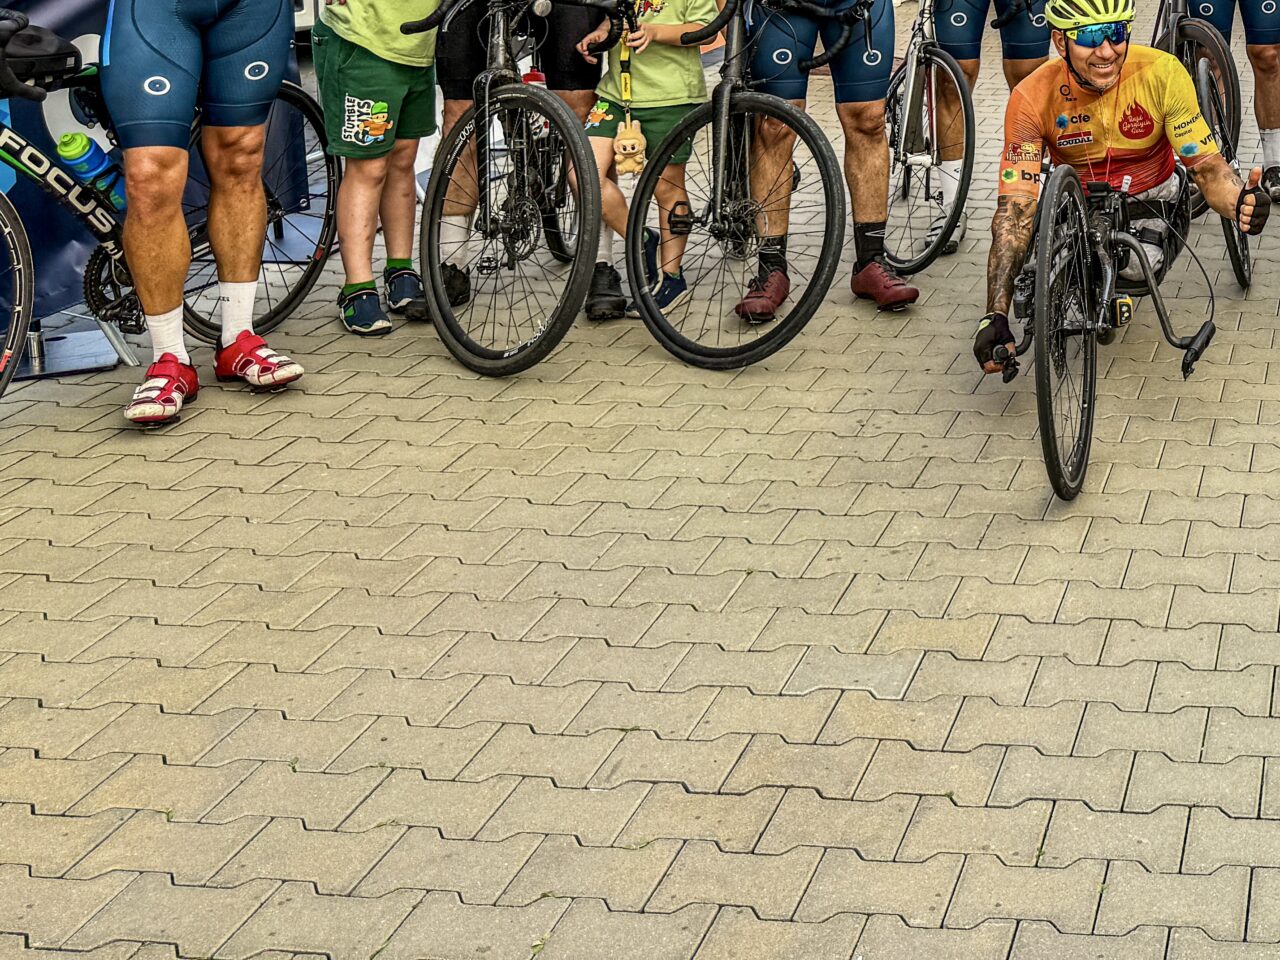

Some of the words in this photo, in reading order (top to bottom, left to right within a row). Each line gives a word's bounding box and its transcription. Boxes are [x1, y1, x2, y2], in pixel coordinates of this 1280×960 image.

[343, 96, 356, 140] STUMBLE
[1070, 113, 1091, 124] cfe
[1056, 136, 1093, 147] SOUDAL
[0, 128, 116, 234] FOCUS
[1021, 170, 1041, 184] bp
